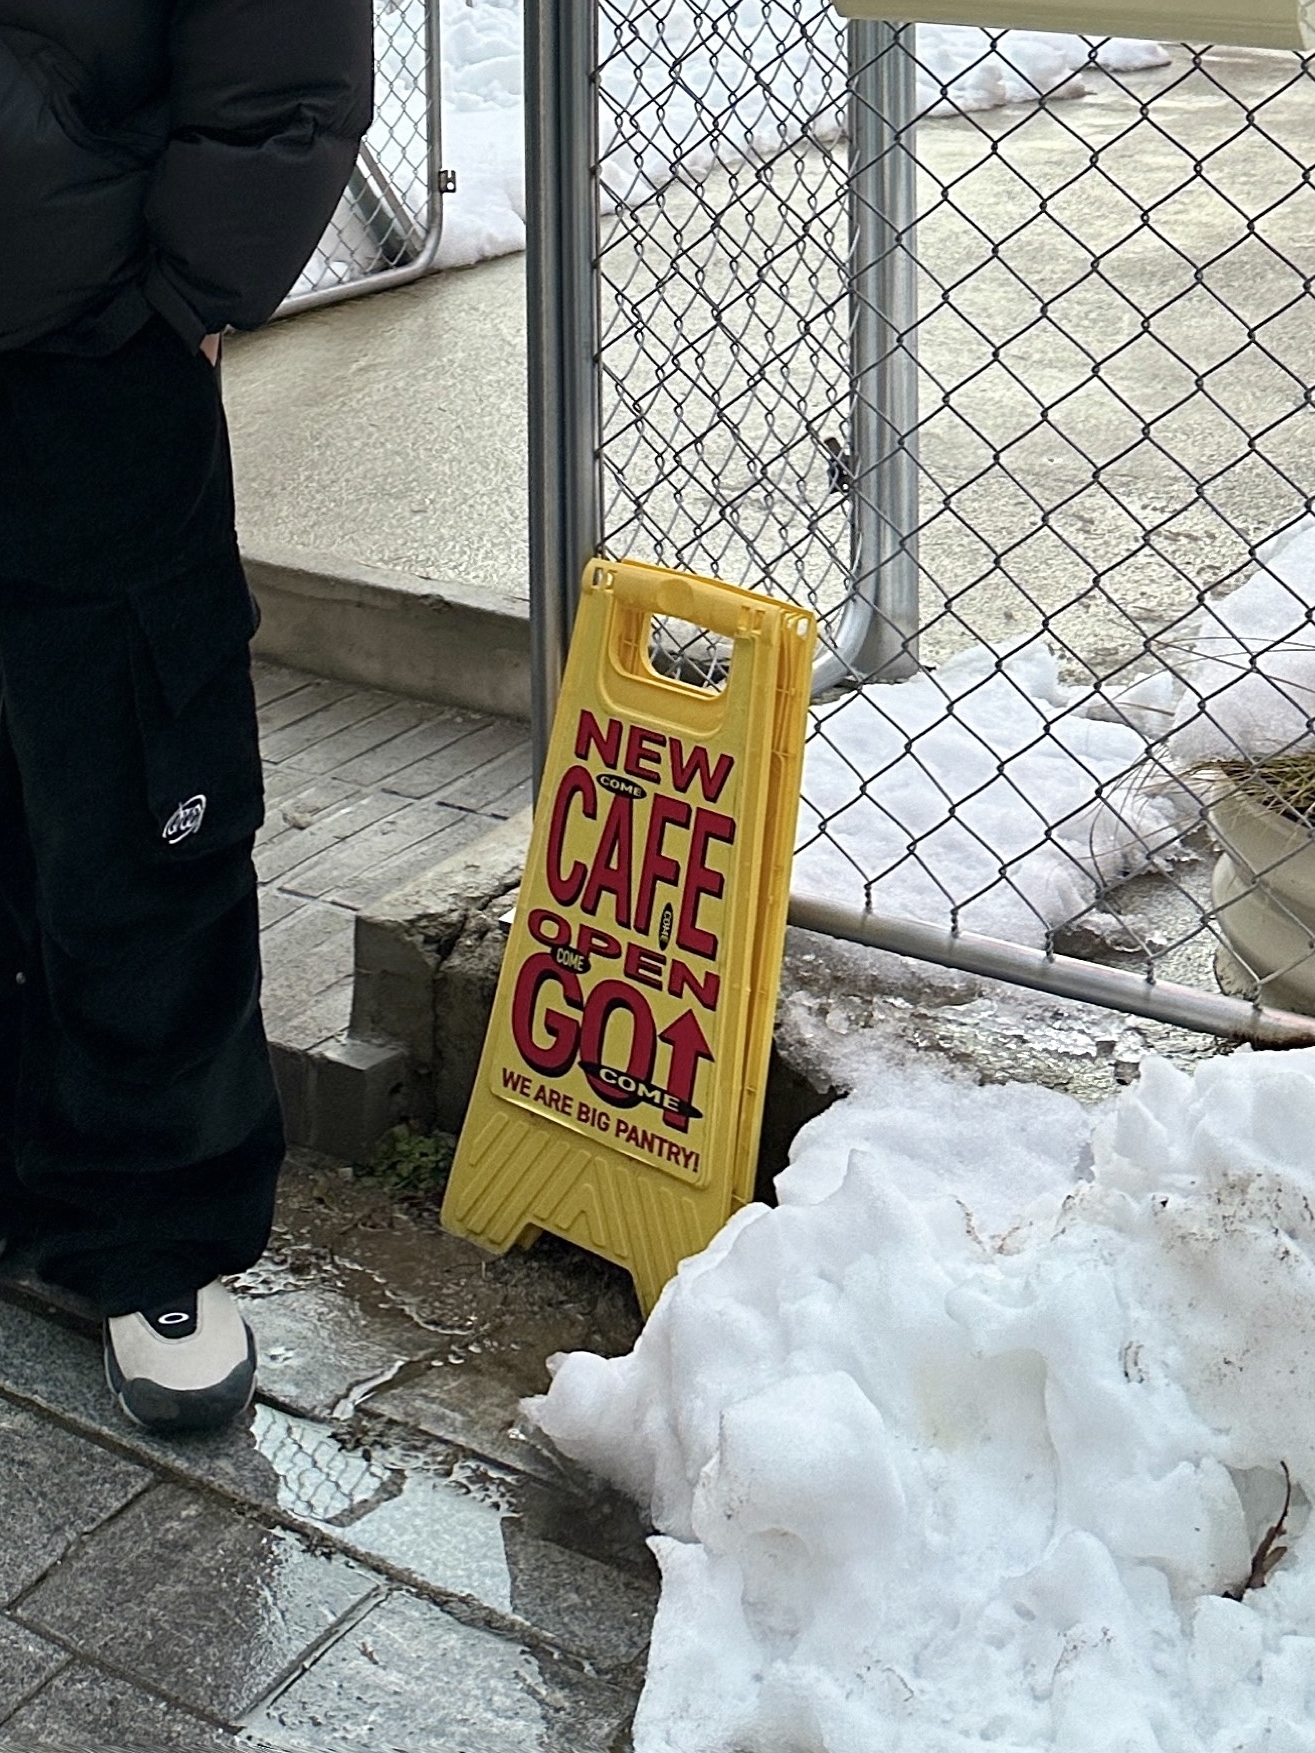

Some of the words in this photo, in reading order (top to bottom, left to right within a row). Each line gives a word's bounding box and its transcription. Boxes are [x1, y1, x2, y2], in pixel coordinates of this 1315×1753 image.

[574, 709, 735, 804] NEW
[599, 775, 643, 798] COME
[546, 764, 736, 962] CAFE
[527, 908, 721, 1012] OPEN
[556, 947, 585, 970] COME
[659, 908, 673, 944] COME
[502, 1067, 533, 1098] WE
[533, 1084, 574, 1117] ARE
[576, 1104, 611, 1132] BIG
[615, 1118, 701, 1173] PANTRY!
[599, 1067, 681, 1113] COME
